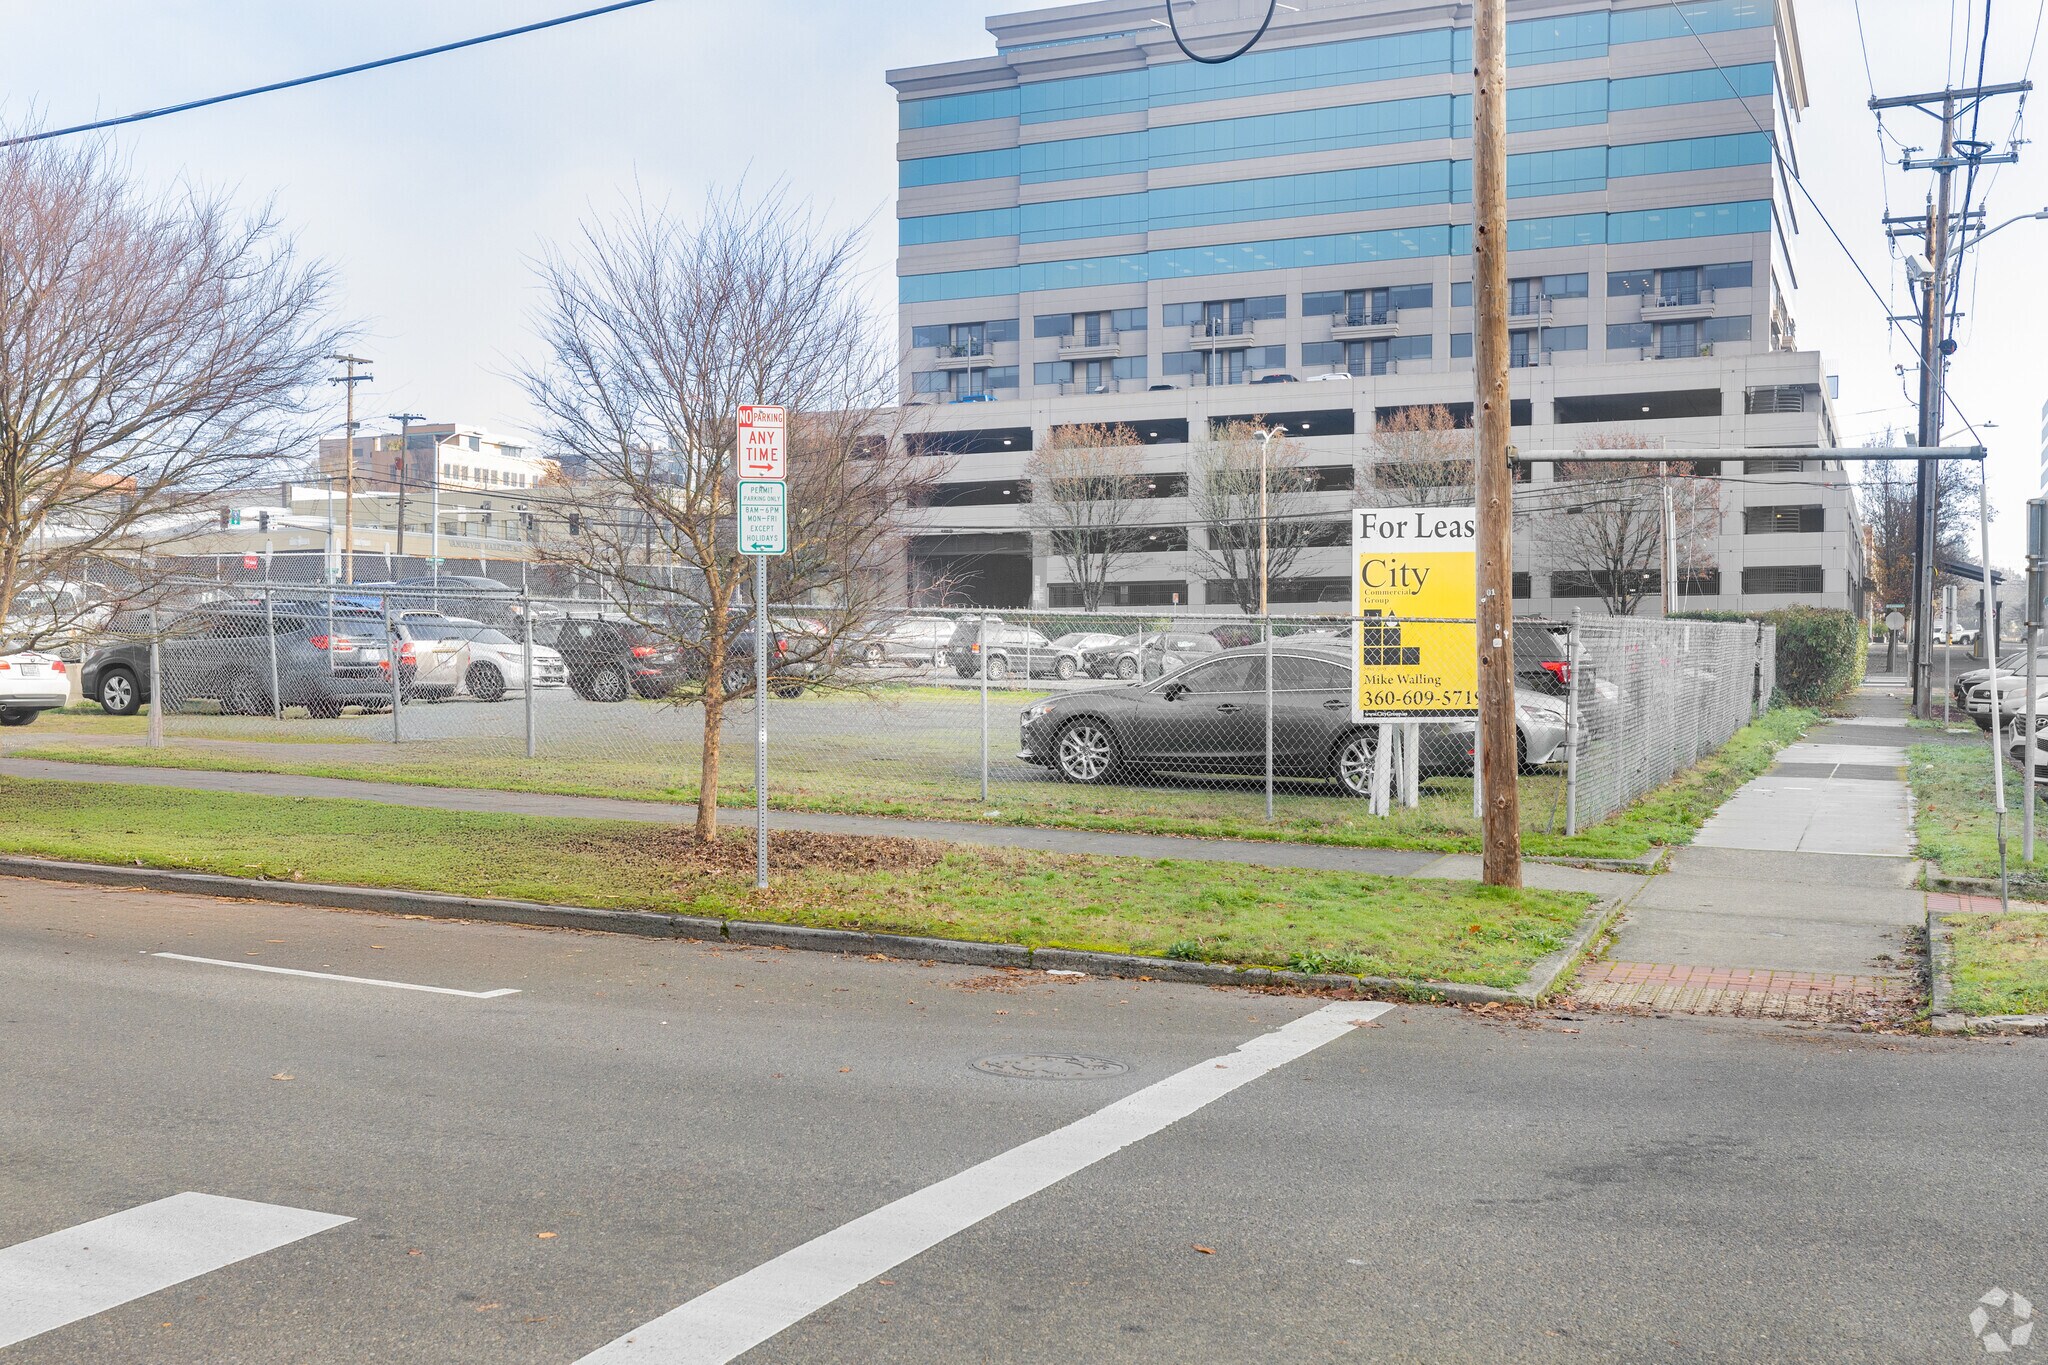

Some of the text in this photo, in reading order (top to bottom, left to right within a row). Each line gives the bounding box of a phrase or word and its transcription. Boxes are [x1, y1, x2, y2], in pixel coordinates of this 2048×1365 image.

[739, 410, 783, 424] NO PARKING
[749, 431, 775, 445] ANY
[746, 447, 778, 461] TIME
[750, 486, 773, 494] PERMIT
[1360, 512, 1475, 539] For Leas
[1361, 558, 1430, 595] City
[1364, 674, 1442, 687] Mike Walling
